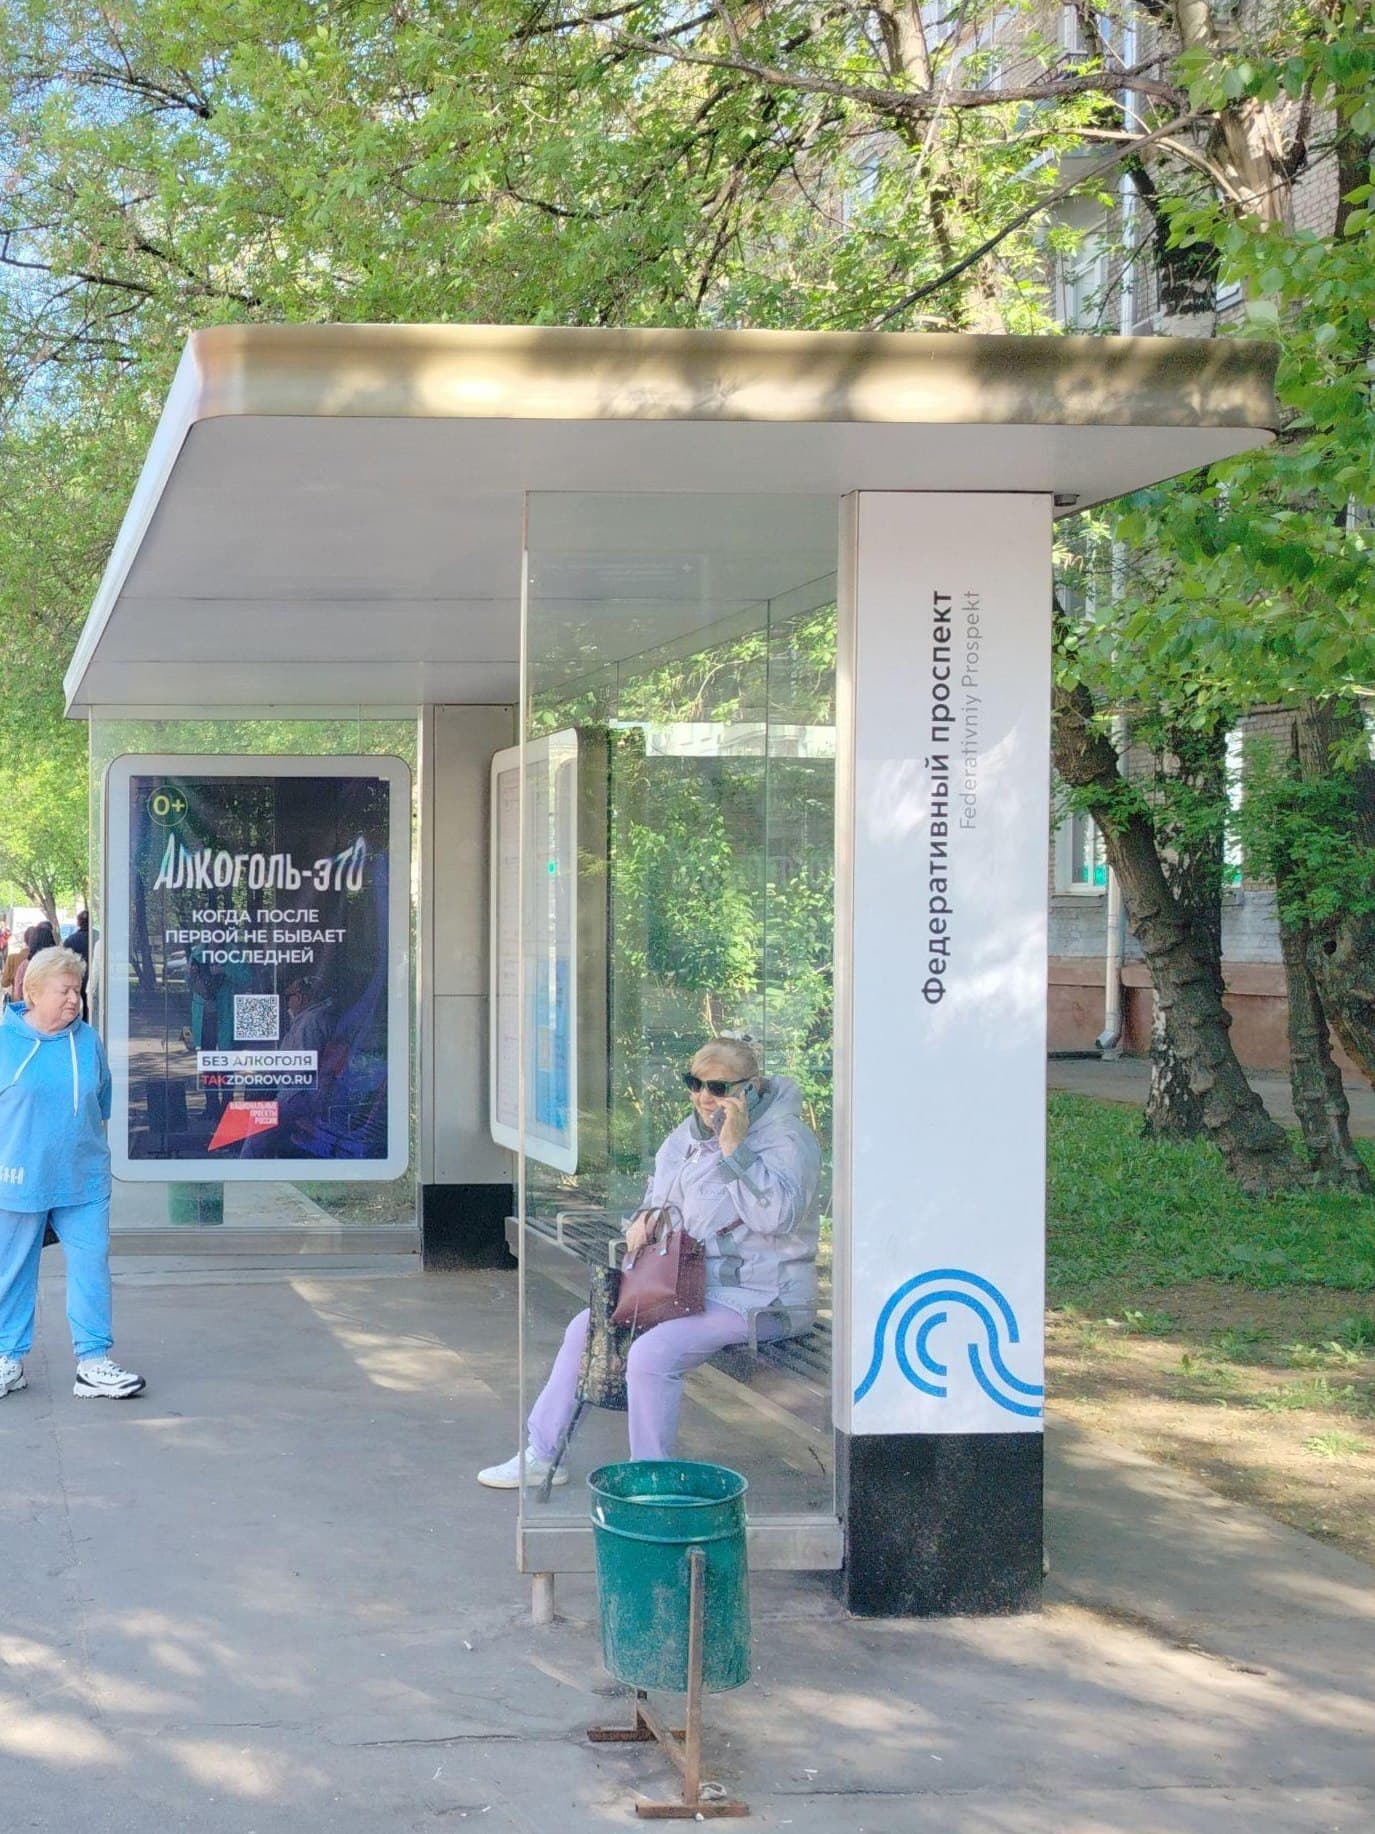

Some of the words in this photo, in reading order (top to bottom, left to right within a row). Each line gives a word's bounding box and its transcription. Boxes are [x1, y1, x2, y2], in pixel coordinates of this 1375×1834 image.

[961, 590, 983, 688] Prospekt
[930, 590, 956, 743] проспект
[959, 694, 983, 831] Federativniy
[153, 795, 185, 816] 0+
[921, 753, 953, 1005] Федеративный
[192, 909, 252, 926] КОГДА
[257, 909, 320, 924] ПОСЛЕ
[166, 927, 239, 944] ПЕРВОЙ
[244, 929, 269, 943] НЕ
[273, 929, 346, 943] БЫВАЕТ
[202, 947, 314, 966] ПОСЛЕДНЕЙ
[202, 1056, 229, 1066] БЕЗ
[232, 1055, 312, 1067] АЛКОГОЛЯ
[202, 1074, 313, 1085] TAKZDOROVO.RU
